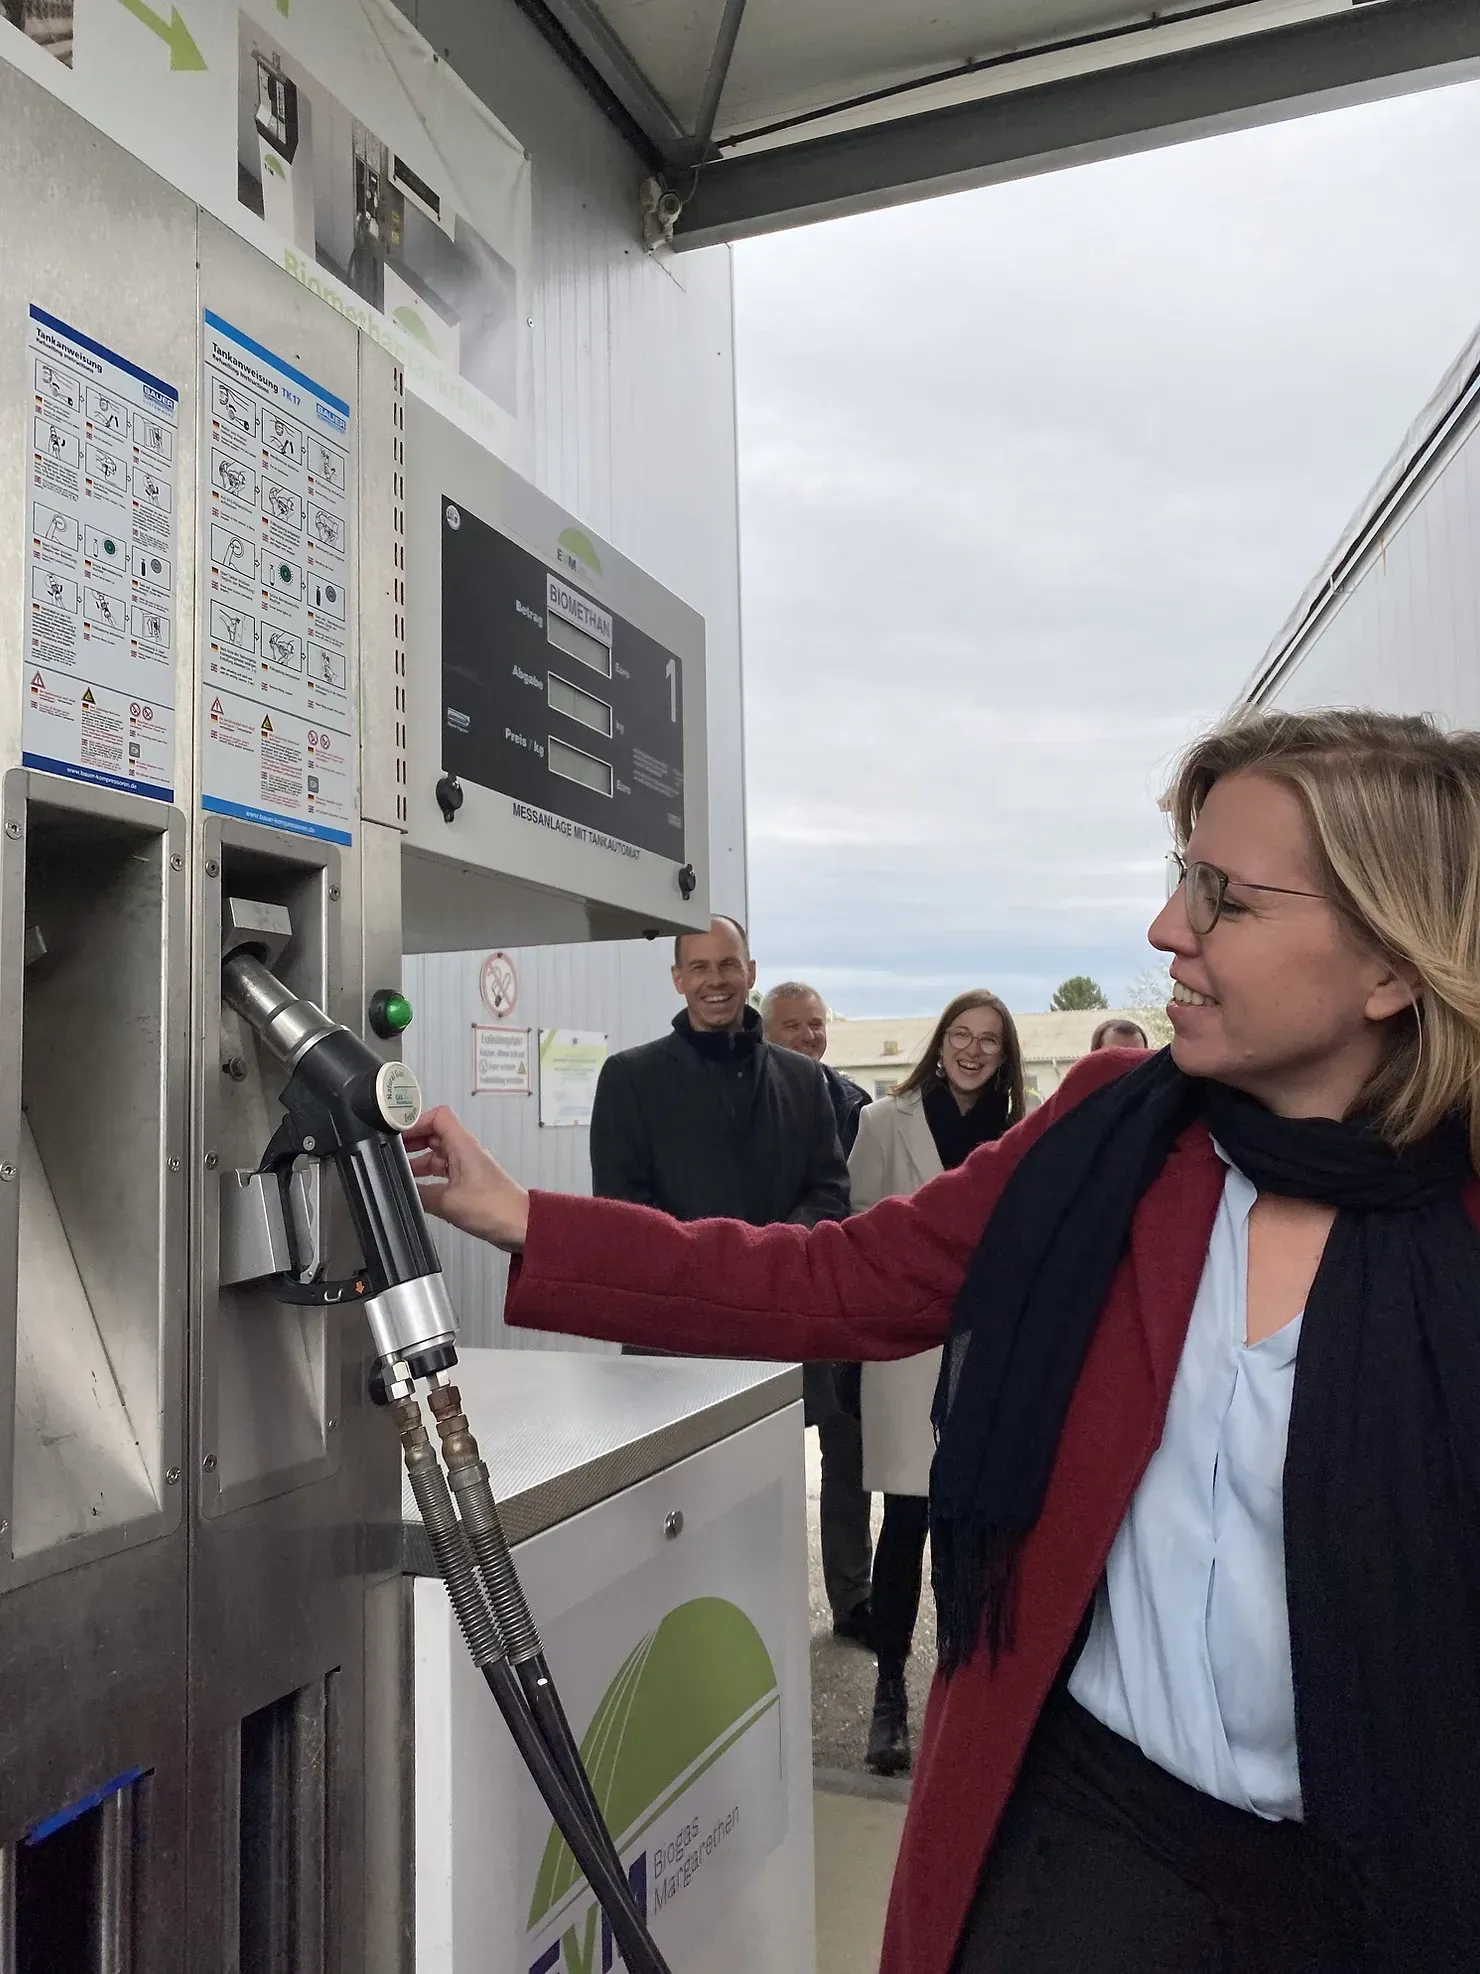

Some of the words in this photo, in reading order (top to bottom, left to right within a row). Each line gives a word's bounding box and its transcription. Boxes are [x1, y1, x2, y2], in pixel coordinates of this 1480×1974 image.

[36, 327, 103, 374] Tankanweisung
[212, 353, 239, 377] Refuelling
[212, 341, 280, 395] Tankanweisung
[144, 386, 174, 408] BAUER
[317, 405, 345, 429] BAUER
[515, 599, 544, 629] Betrag
[549, 583, 611, 638] BIOMETHAN
[512, 664, 544, 690] Abgabe
[665, 658, 677, 723] 1
[505, 727, 527, 747] Preis
[533, 740, 545, 758] kg
[512, 802, 572, 837] MESSANLAGE
[573, 825, 587, 842] MIT
[588, 831, 641, 860] TANKAUTOMAT
[387, 1072, 396, 1100] Natural
[653, 1815, 700, 1880] Biogas
[653, 1805, 740, 1916] Margarethen
